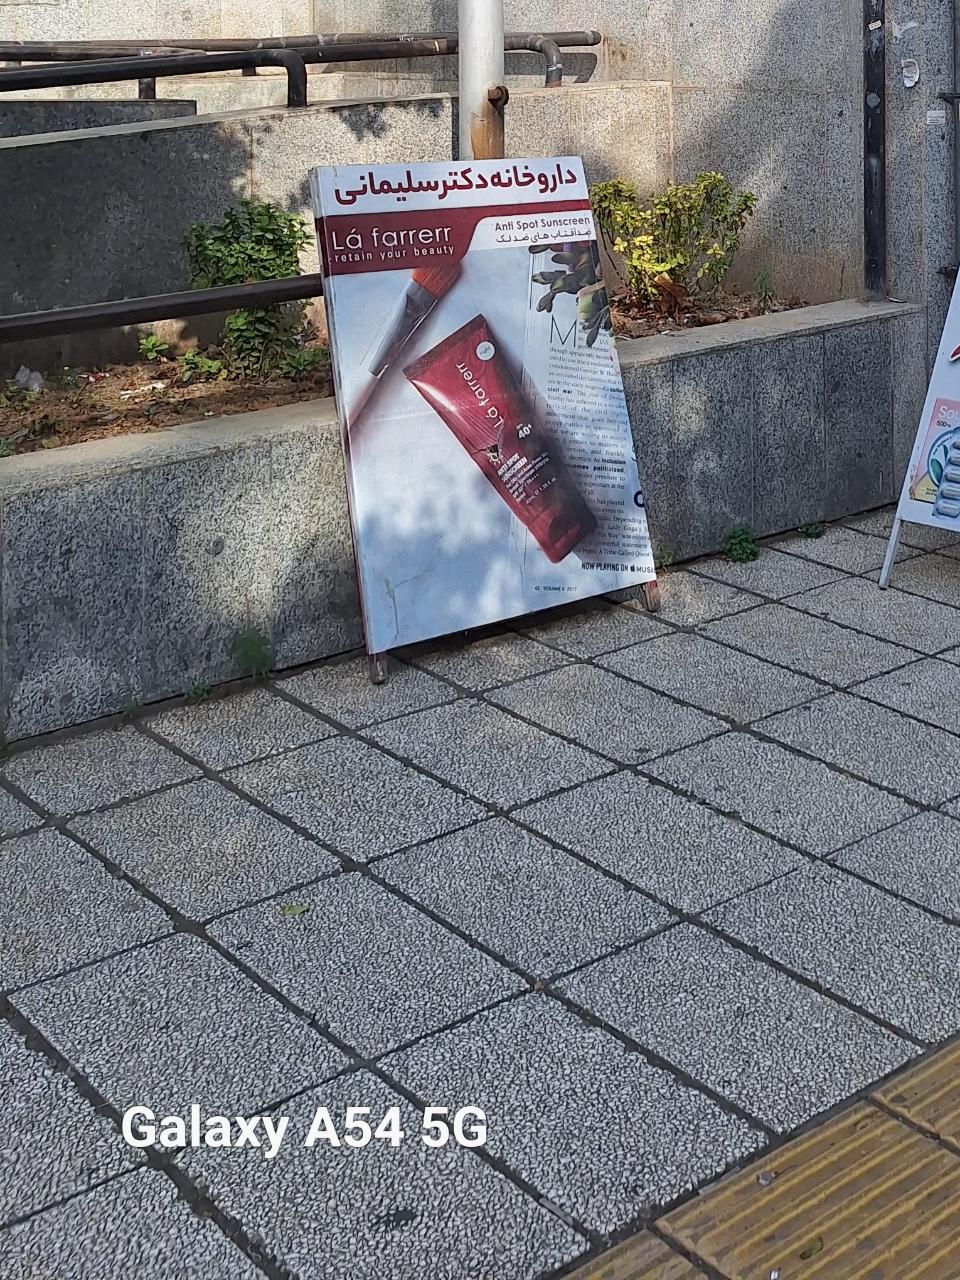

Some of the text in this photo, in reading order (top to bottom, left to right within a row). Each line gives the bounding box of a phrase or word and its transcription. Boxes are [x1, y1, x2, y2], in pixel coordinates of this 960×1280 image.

[334, 163, 578, 206] داروخانه دکتر سلیمانی
[495, 216, 591, 233] Anti Spot Sunscreen
[371, 225, 453, 248] farrerr
[334, 243, 455, 264] retain your beauty
[581, 561, 655, 574] NOW PLAYING ON MUSI
